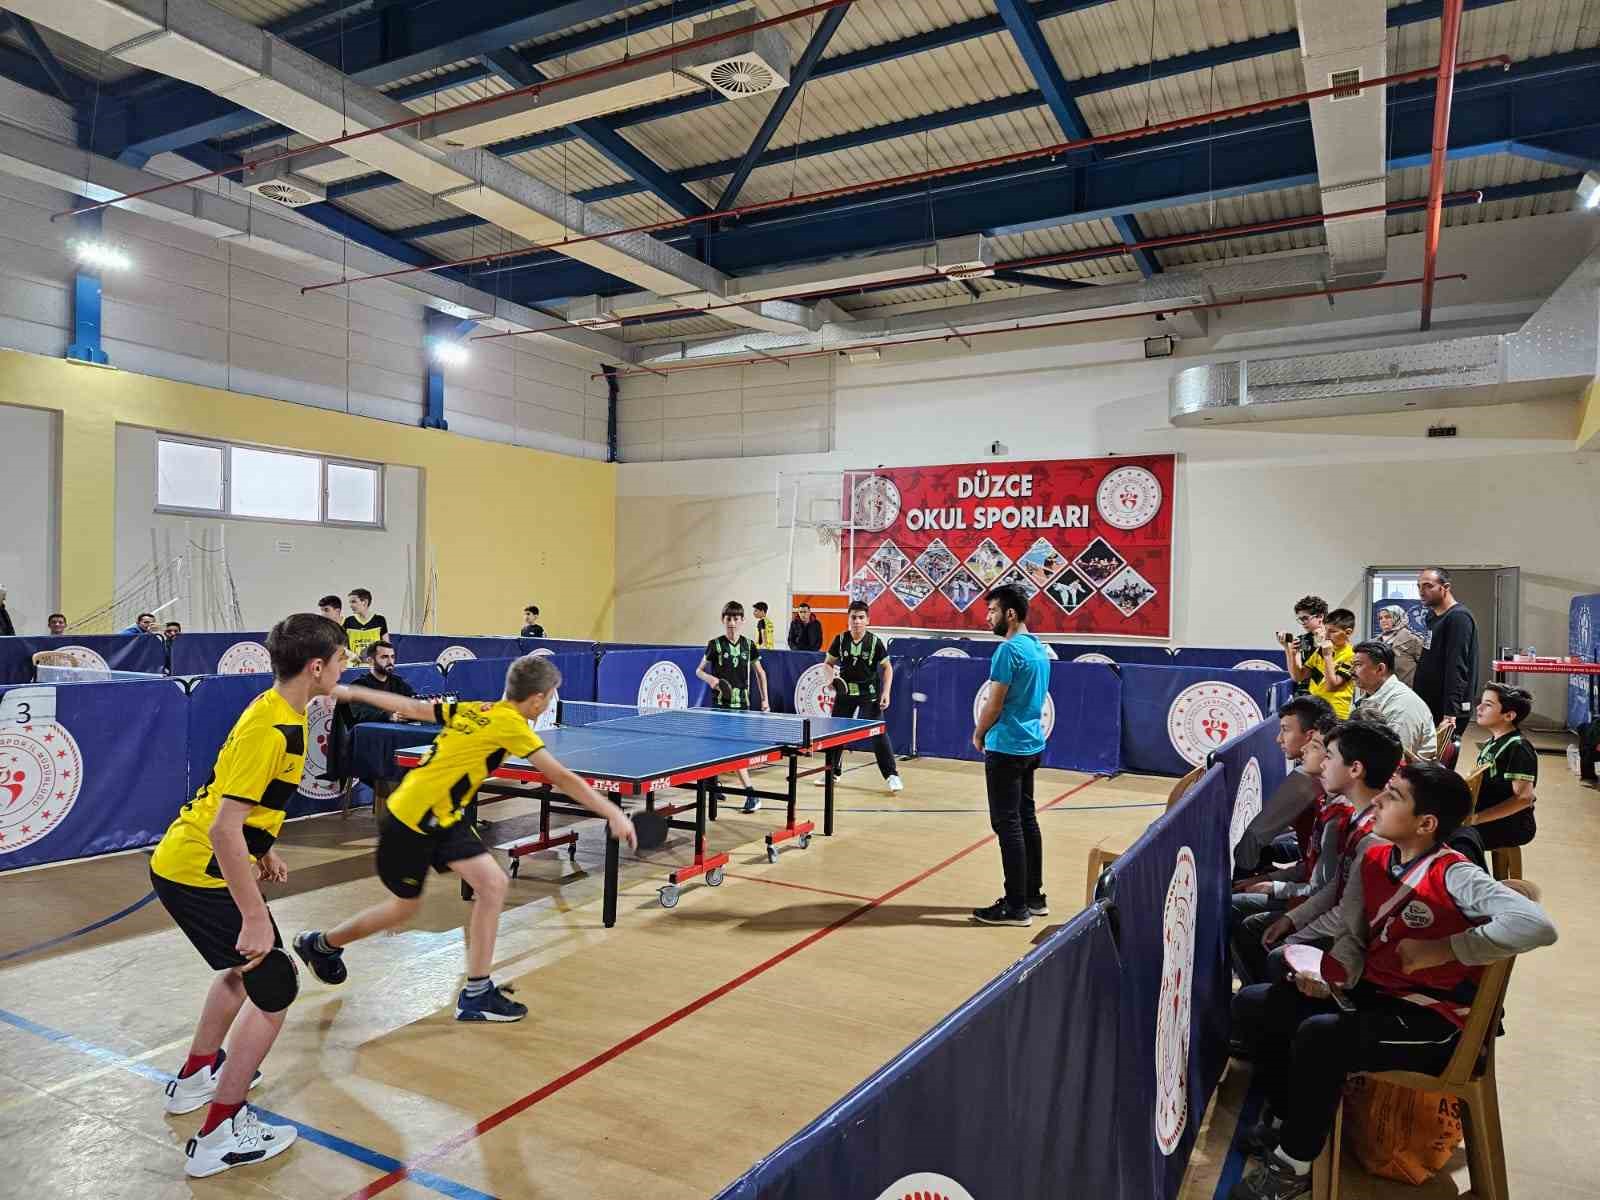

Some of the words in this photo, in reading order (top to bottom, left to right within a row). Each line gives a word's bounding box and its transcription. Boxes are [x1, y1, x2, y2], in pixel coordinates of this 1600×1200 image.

[958, 469, 1033, 498] DÜZCE
[906, 507, 967, 531] OKUL
[974, 504, 1089, 530] SPORLARI
[16, 702, 31, 724] 3
